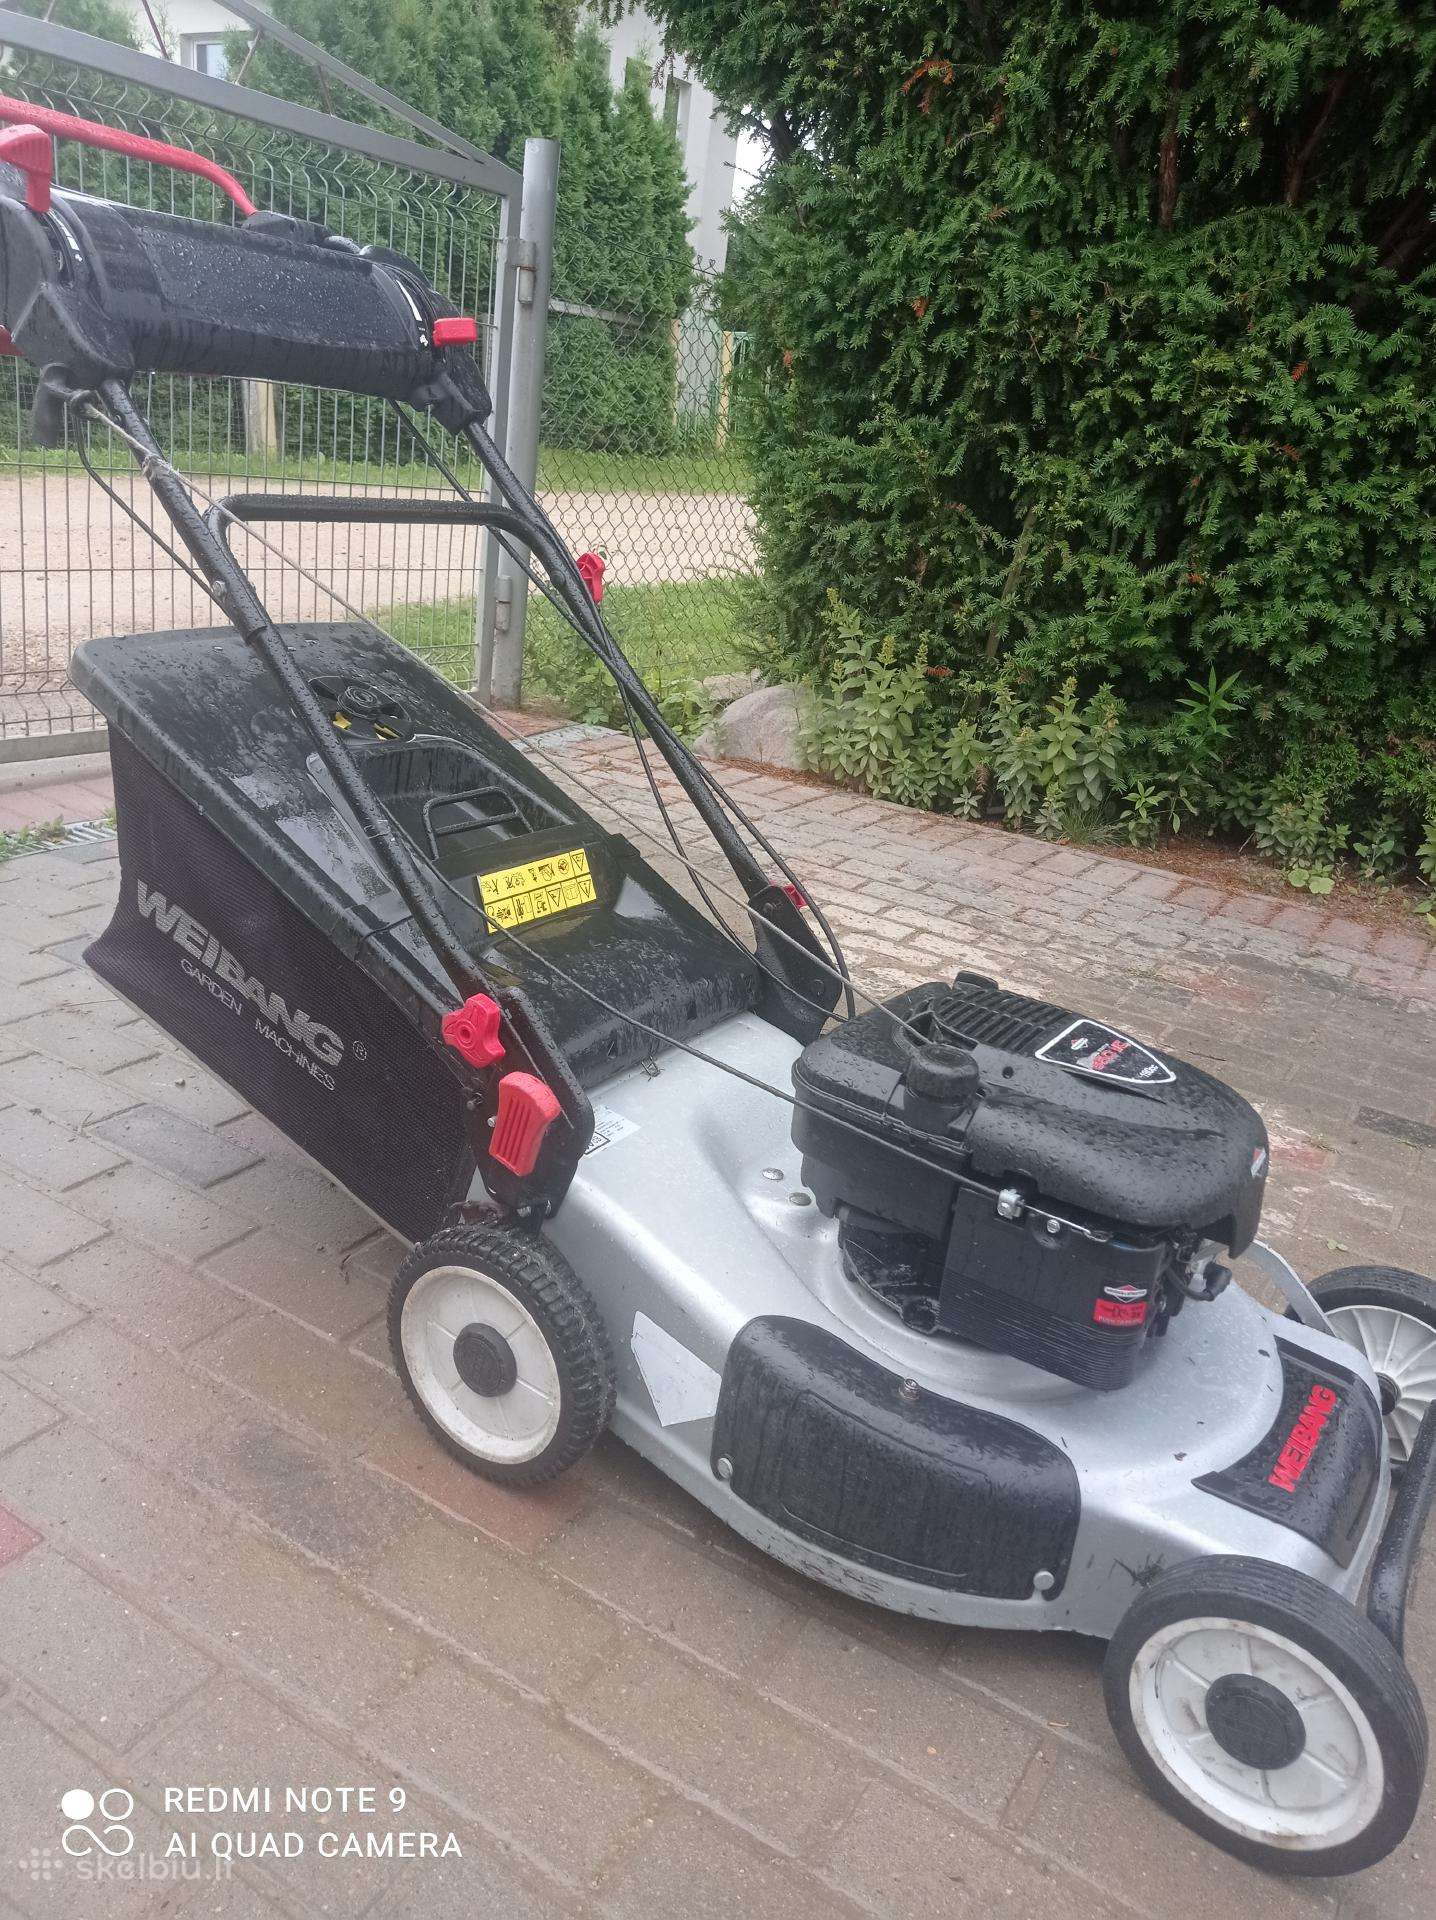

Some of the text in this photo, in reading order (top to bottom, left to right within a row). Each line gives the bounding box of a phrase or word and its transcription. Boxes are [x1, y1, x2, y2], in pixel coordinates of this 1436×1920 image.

[137, 878, 345, 1067] WEIBANG
[180, 958, 336, 1091] GARDEN MACHINES
[1268, 1384, 1338, 1494] WEIBANG
